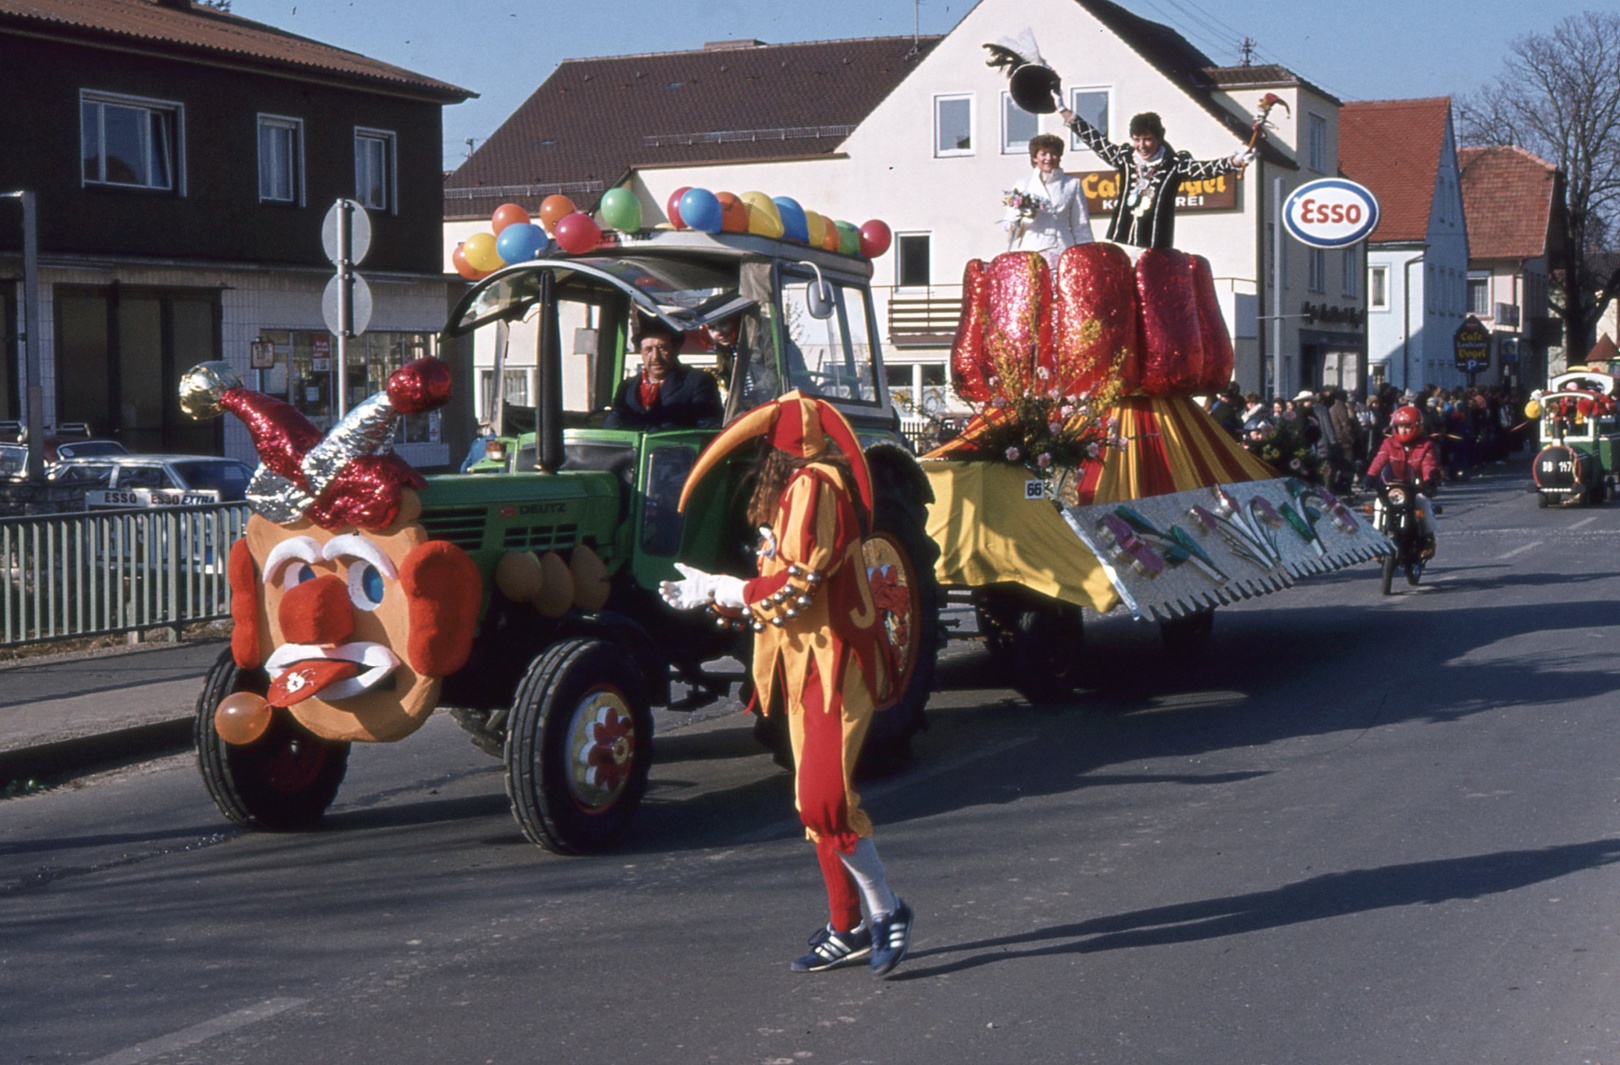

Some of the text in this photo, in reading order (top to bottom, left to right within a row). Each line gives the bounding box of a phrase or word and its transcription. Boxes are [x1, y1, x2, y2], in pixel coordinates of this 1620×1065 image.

[1027, 483, 1042, 496] 66
[104, 492, 137, 504] ESSO
[151, 494, 215, 505] ESSO EXTRA
[520, 502, 567, 514] DEUTZ
